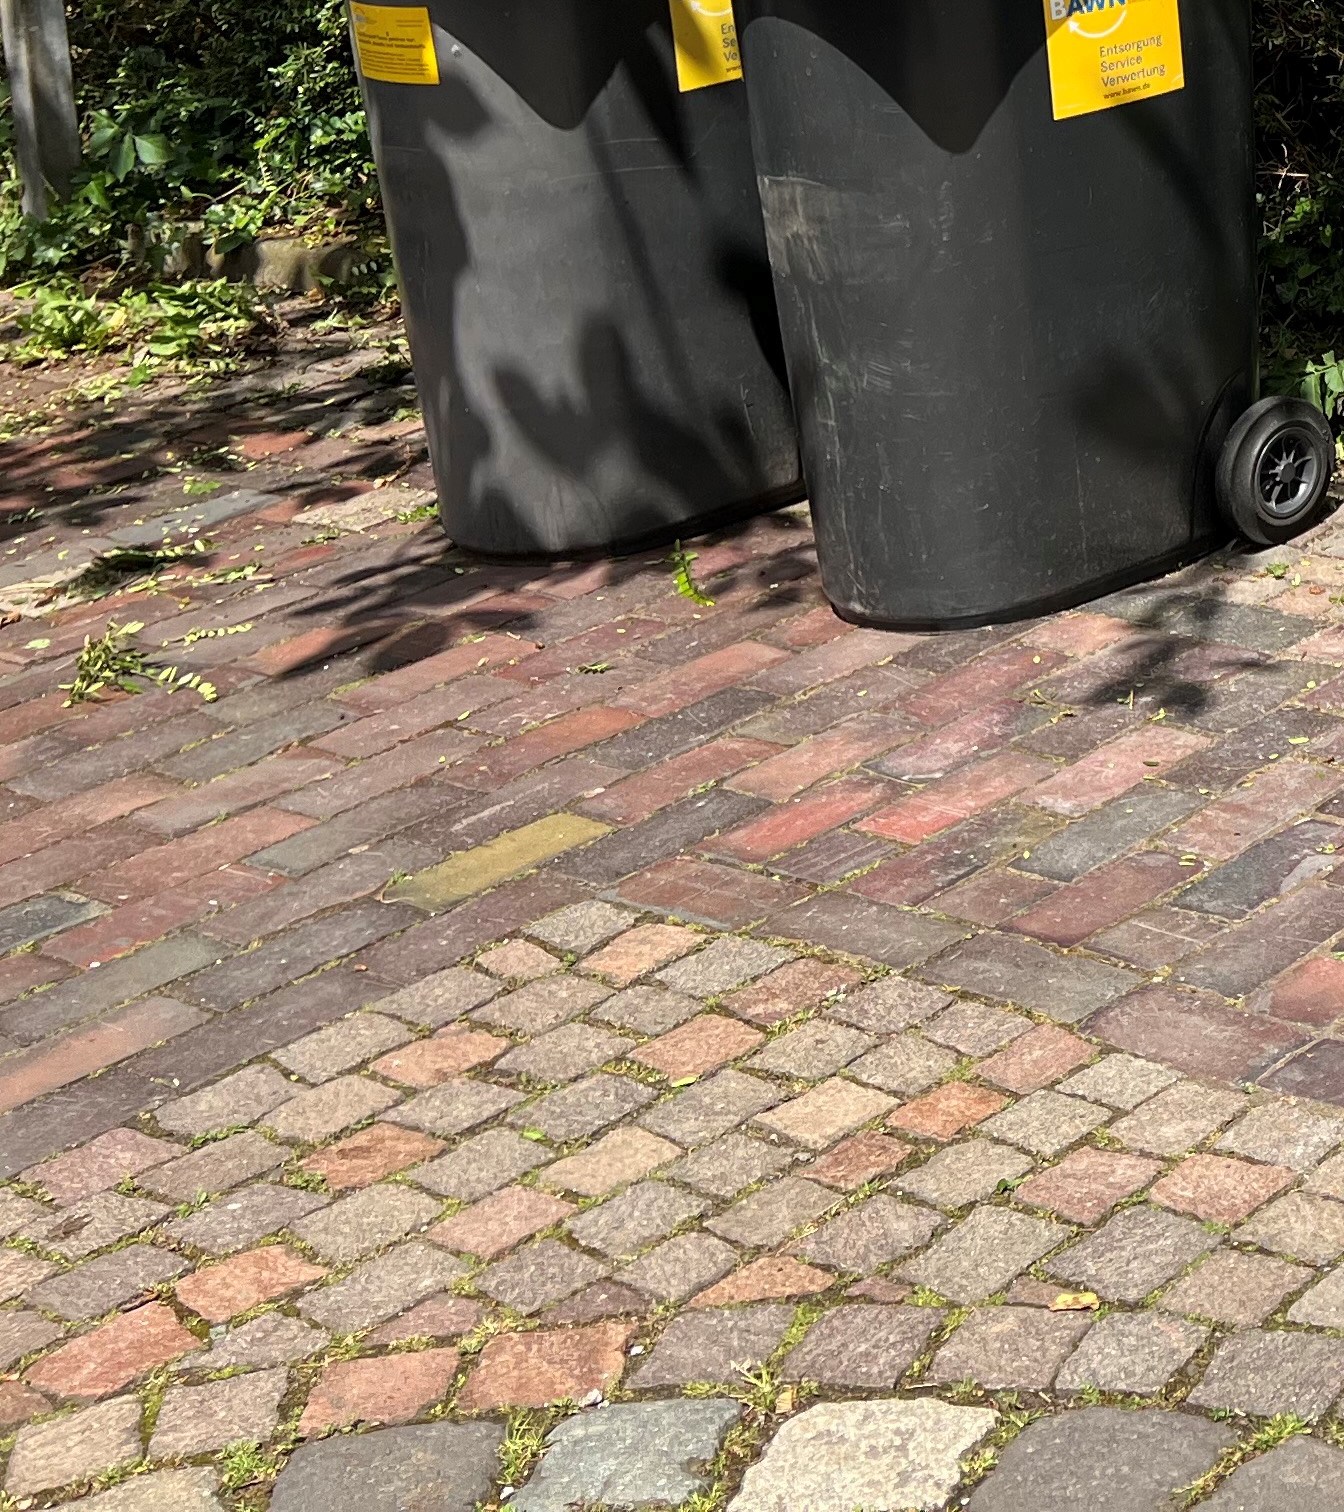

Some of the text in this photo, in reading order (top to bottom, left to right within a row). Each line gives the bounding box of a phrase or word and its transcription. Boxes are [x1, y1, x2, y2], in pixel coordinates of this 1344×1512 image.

[1099, 34, 1163, 58] Entsorgung
[1100, 55, 1143, 73] Service
[1101, 64, 1166, 88] Verwertung
[1103, 82, 1151, 100] www.bawn.de
